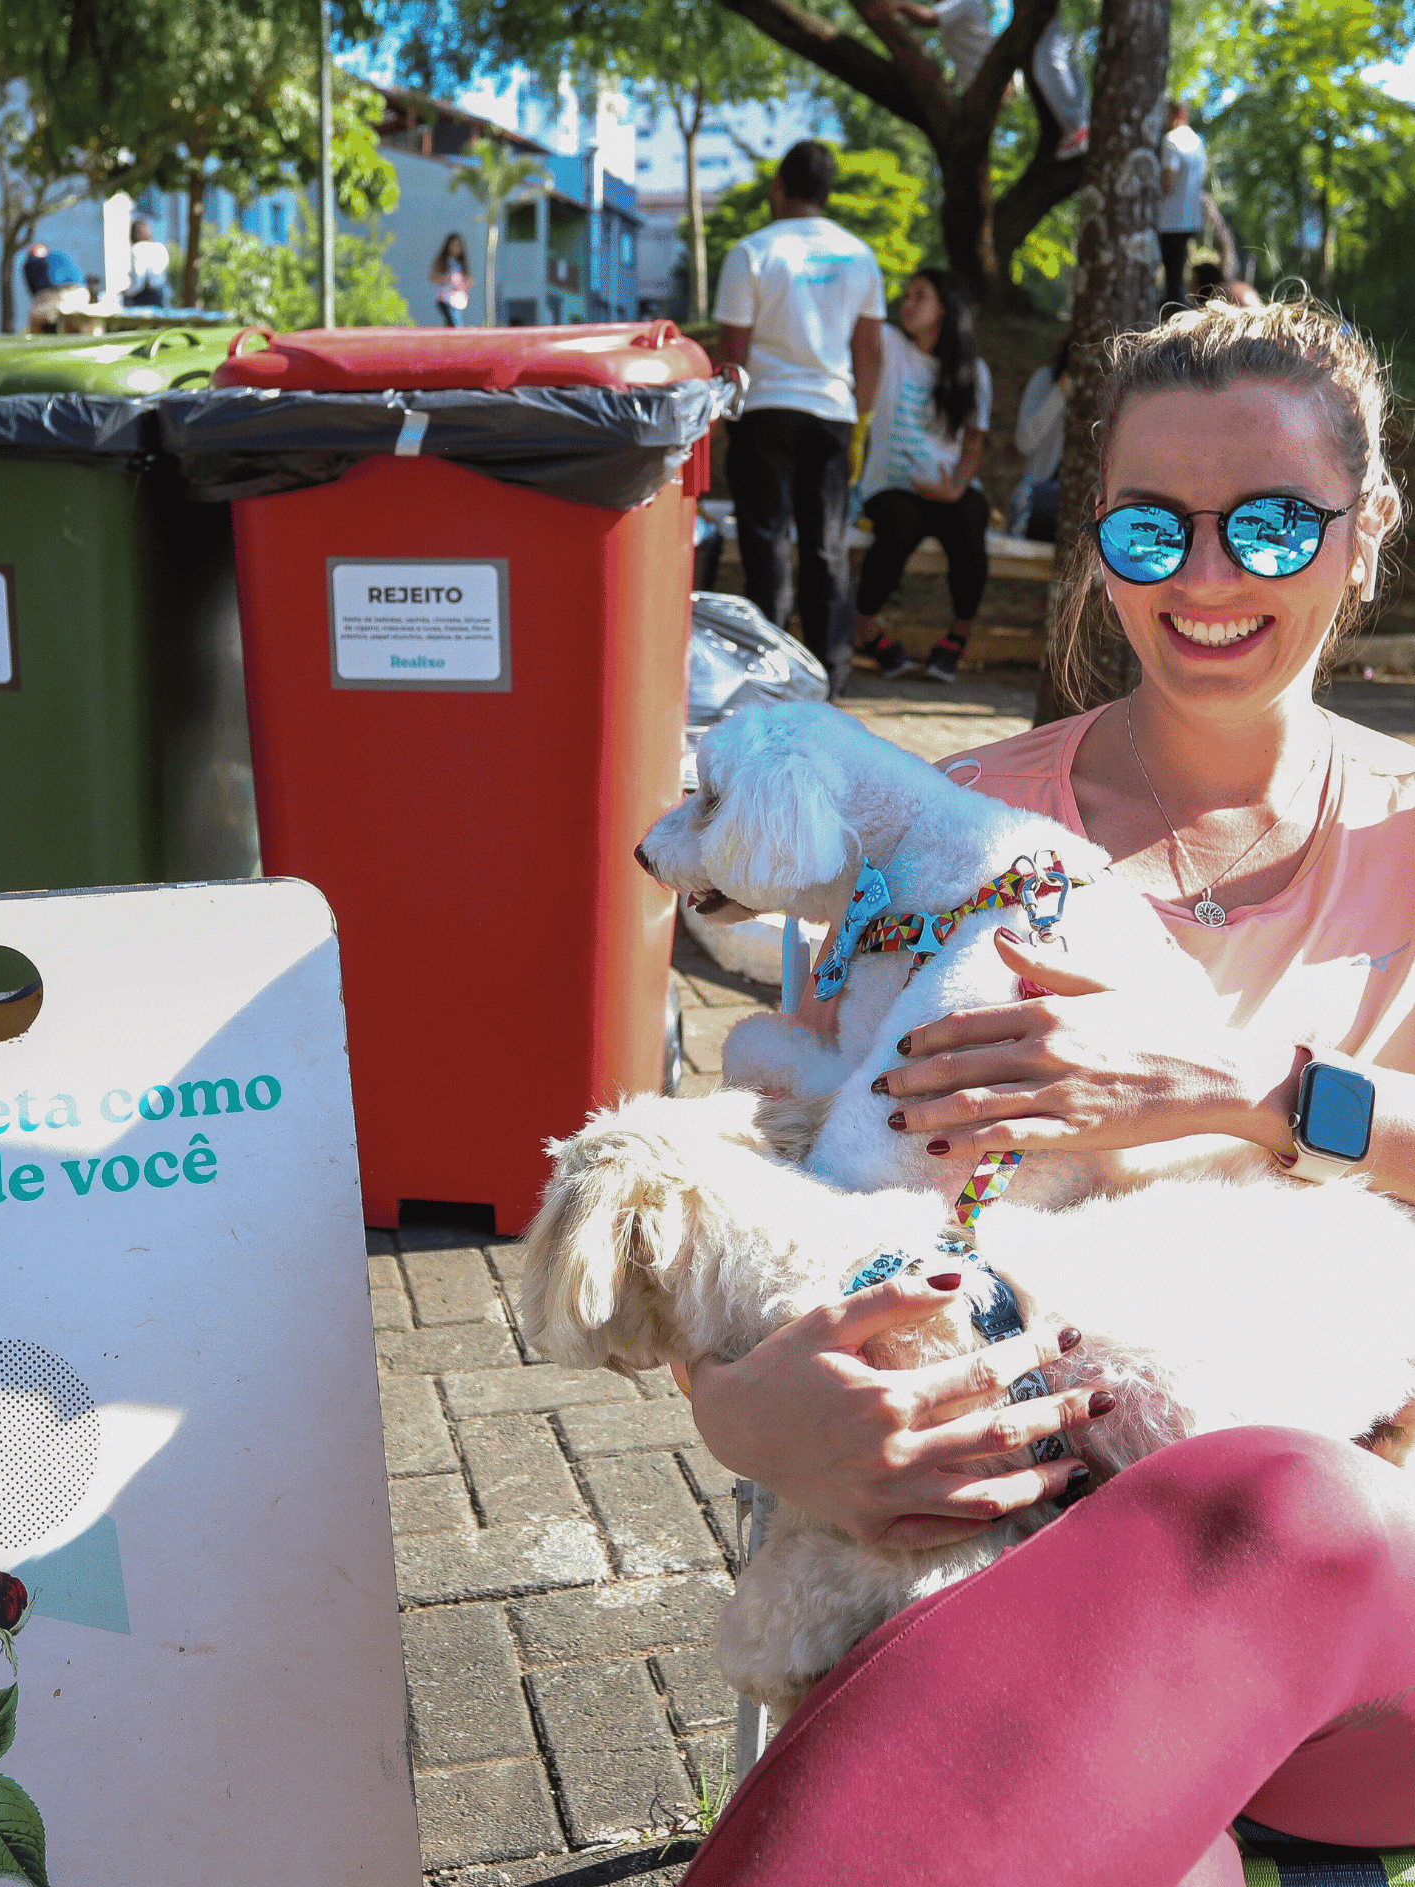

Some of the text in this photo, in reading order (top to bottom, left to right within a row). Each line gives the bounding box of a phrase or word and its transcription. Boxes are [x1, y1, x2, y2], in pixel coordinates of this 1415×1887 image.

[368, 586, 462, 604] REJEITO
[99, 1074, 283, 1125] como
[60, 1134, 218, 1197] você
